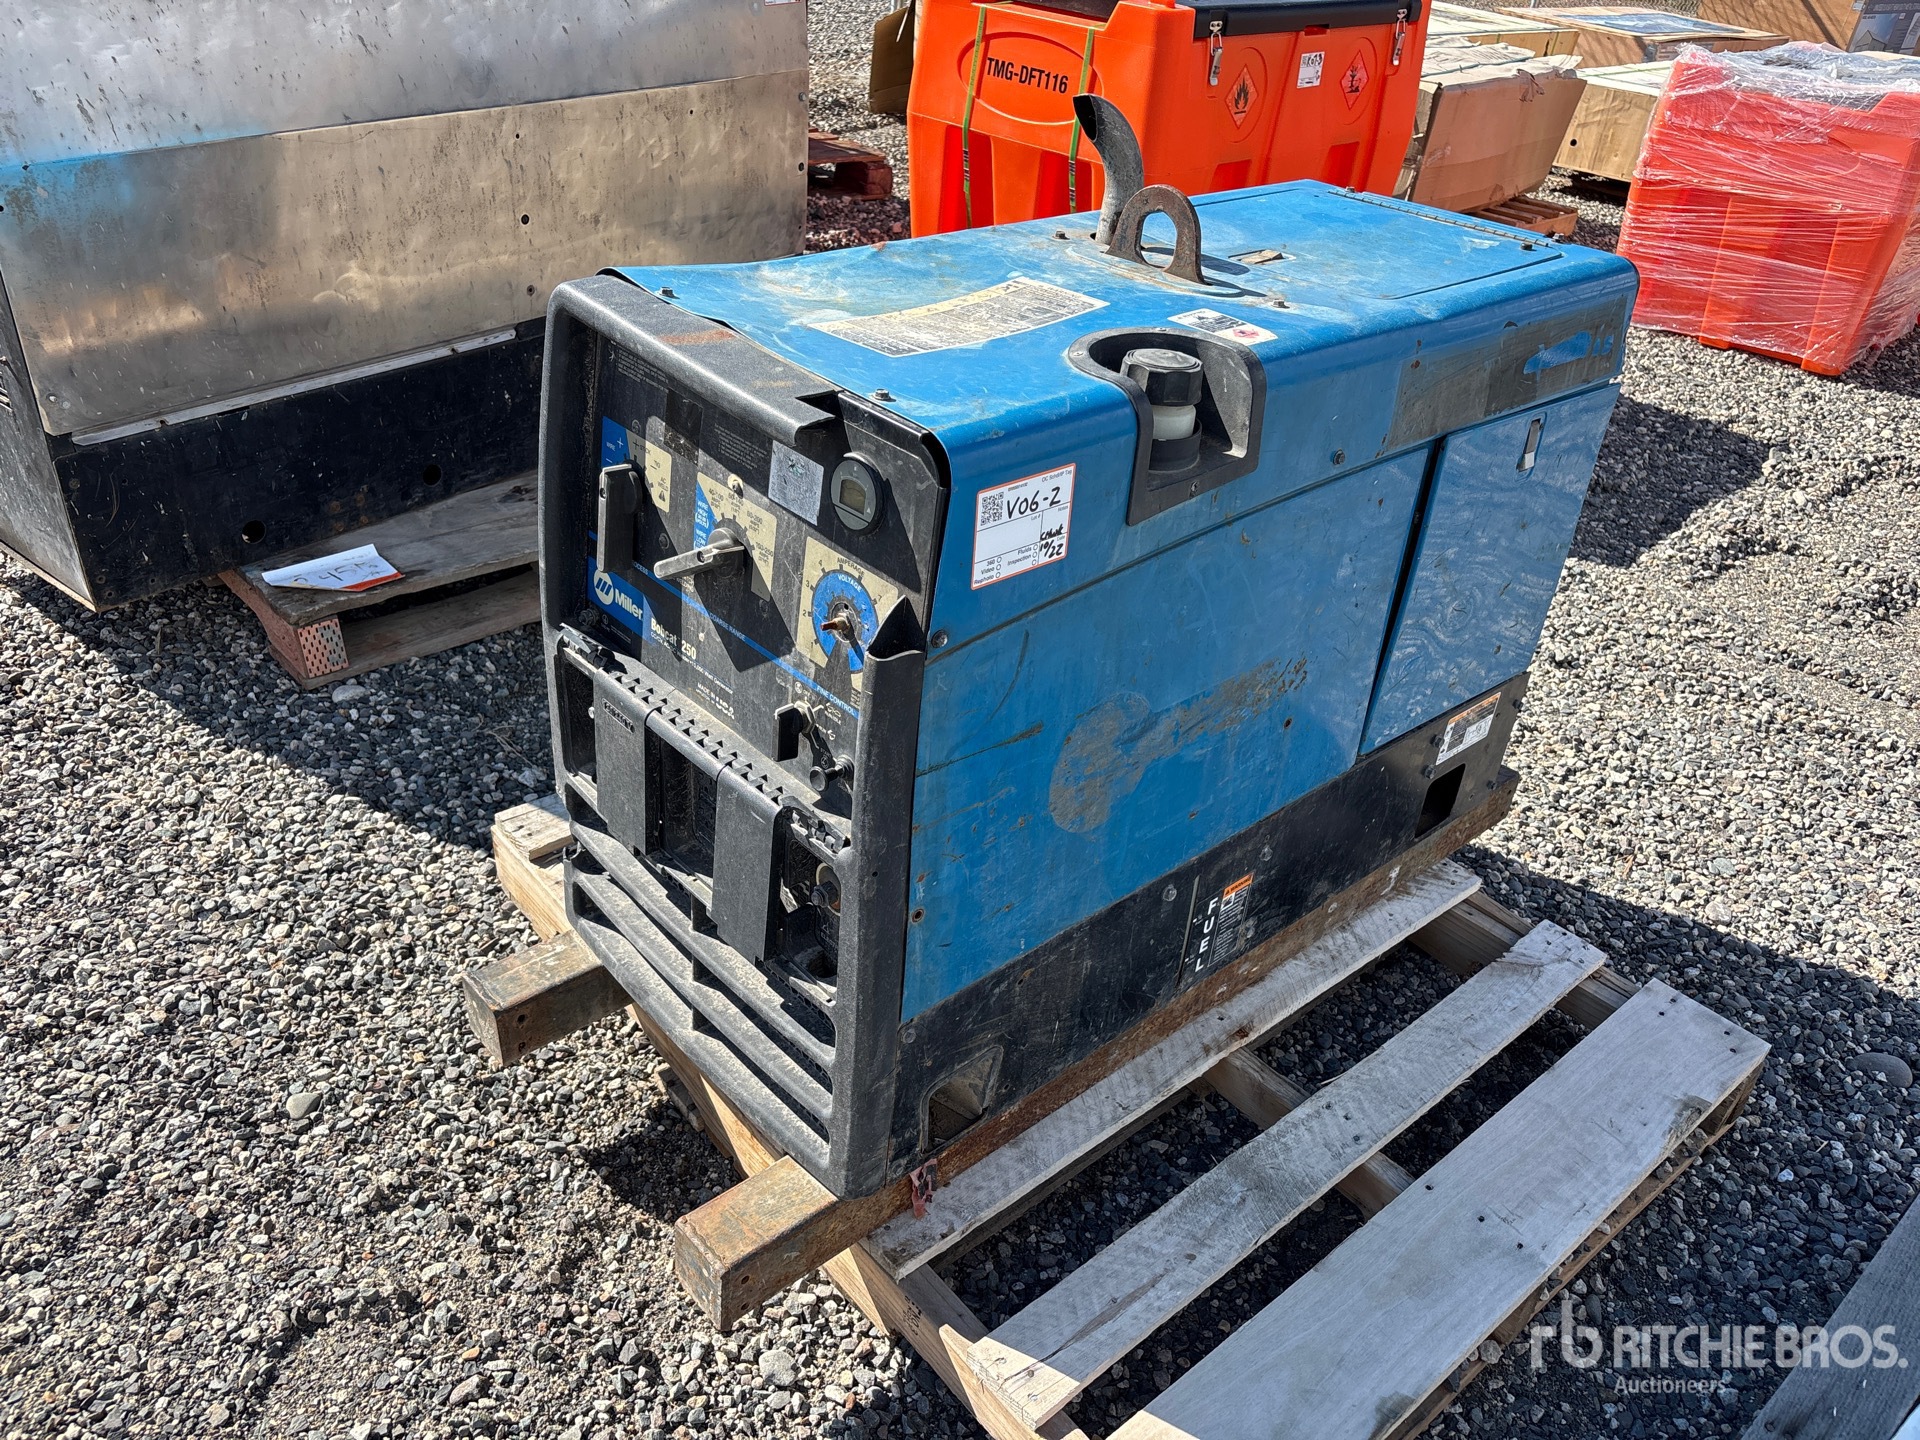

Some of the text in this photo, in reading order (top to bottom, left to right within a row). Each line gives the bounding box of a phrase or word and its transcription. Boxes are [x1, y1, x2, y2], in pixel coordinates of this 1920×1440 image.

[987, 57, 1068, 94] TMG-DFT116
[1007, 486, 1061, 519] V06-2
[837, 556, 865, 577] AMPERAGE
[838, 574, 863, 593] VOLTAGE
[614, 588, 643, 620] Miller
[651, 617, 678, 647] Bobcat
[681, 639, 697, 660] 250
[709, 612, 746, 642] COARSE RANGE
[816, 685, 830, 698] FINE
[829, 694, 855, 716] CONTROL
[1194, 897, 1218, 973] FUEL
